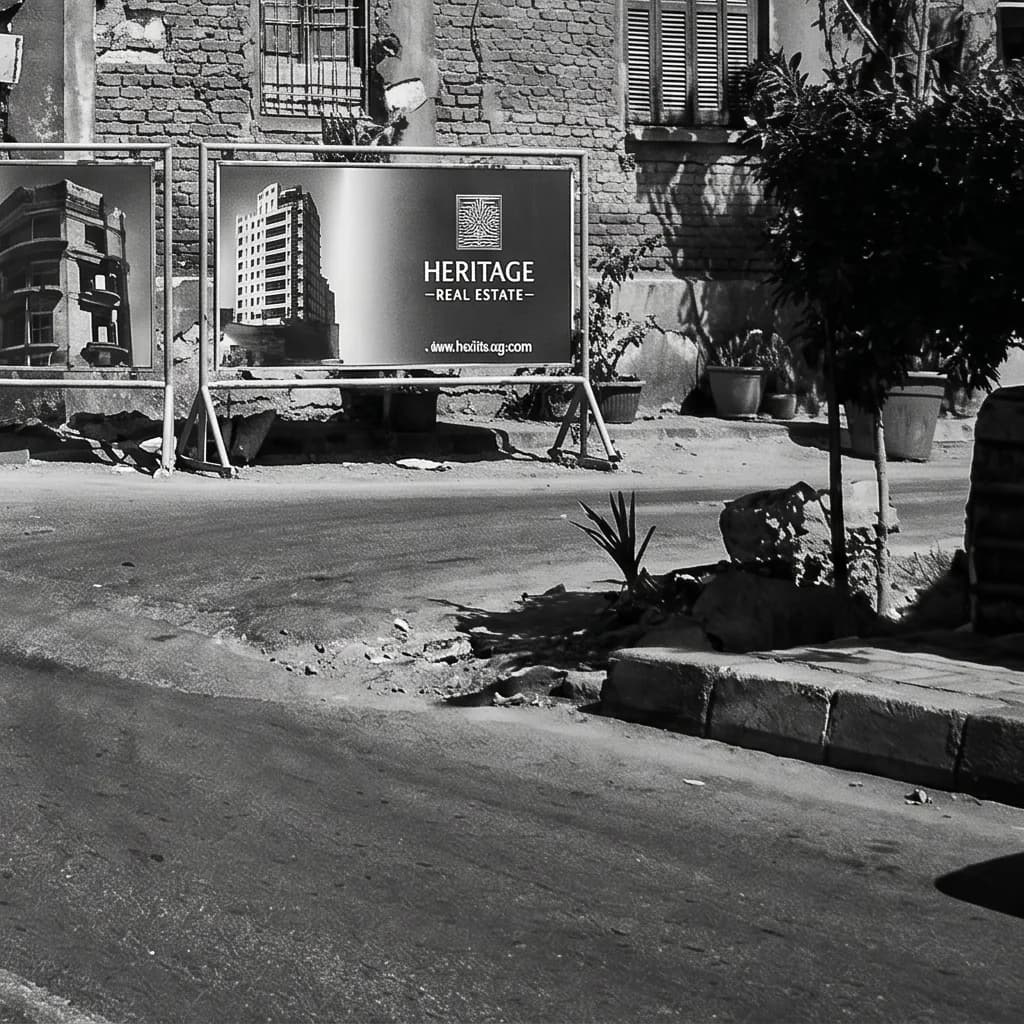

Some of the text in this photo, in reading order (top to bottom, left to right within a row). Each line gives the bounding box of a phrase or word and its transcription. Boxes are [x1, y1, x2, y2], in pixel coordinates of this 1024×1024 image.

[424, 260, 535, 282] HERITAGE
[436, 288, 524, 301] REAL ESTATE
